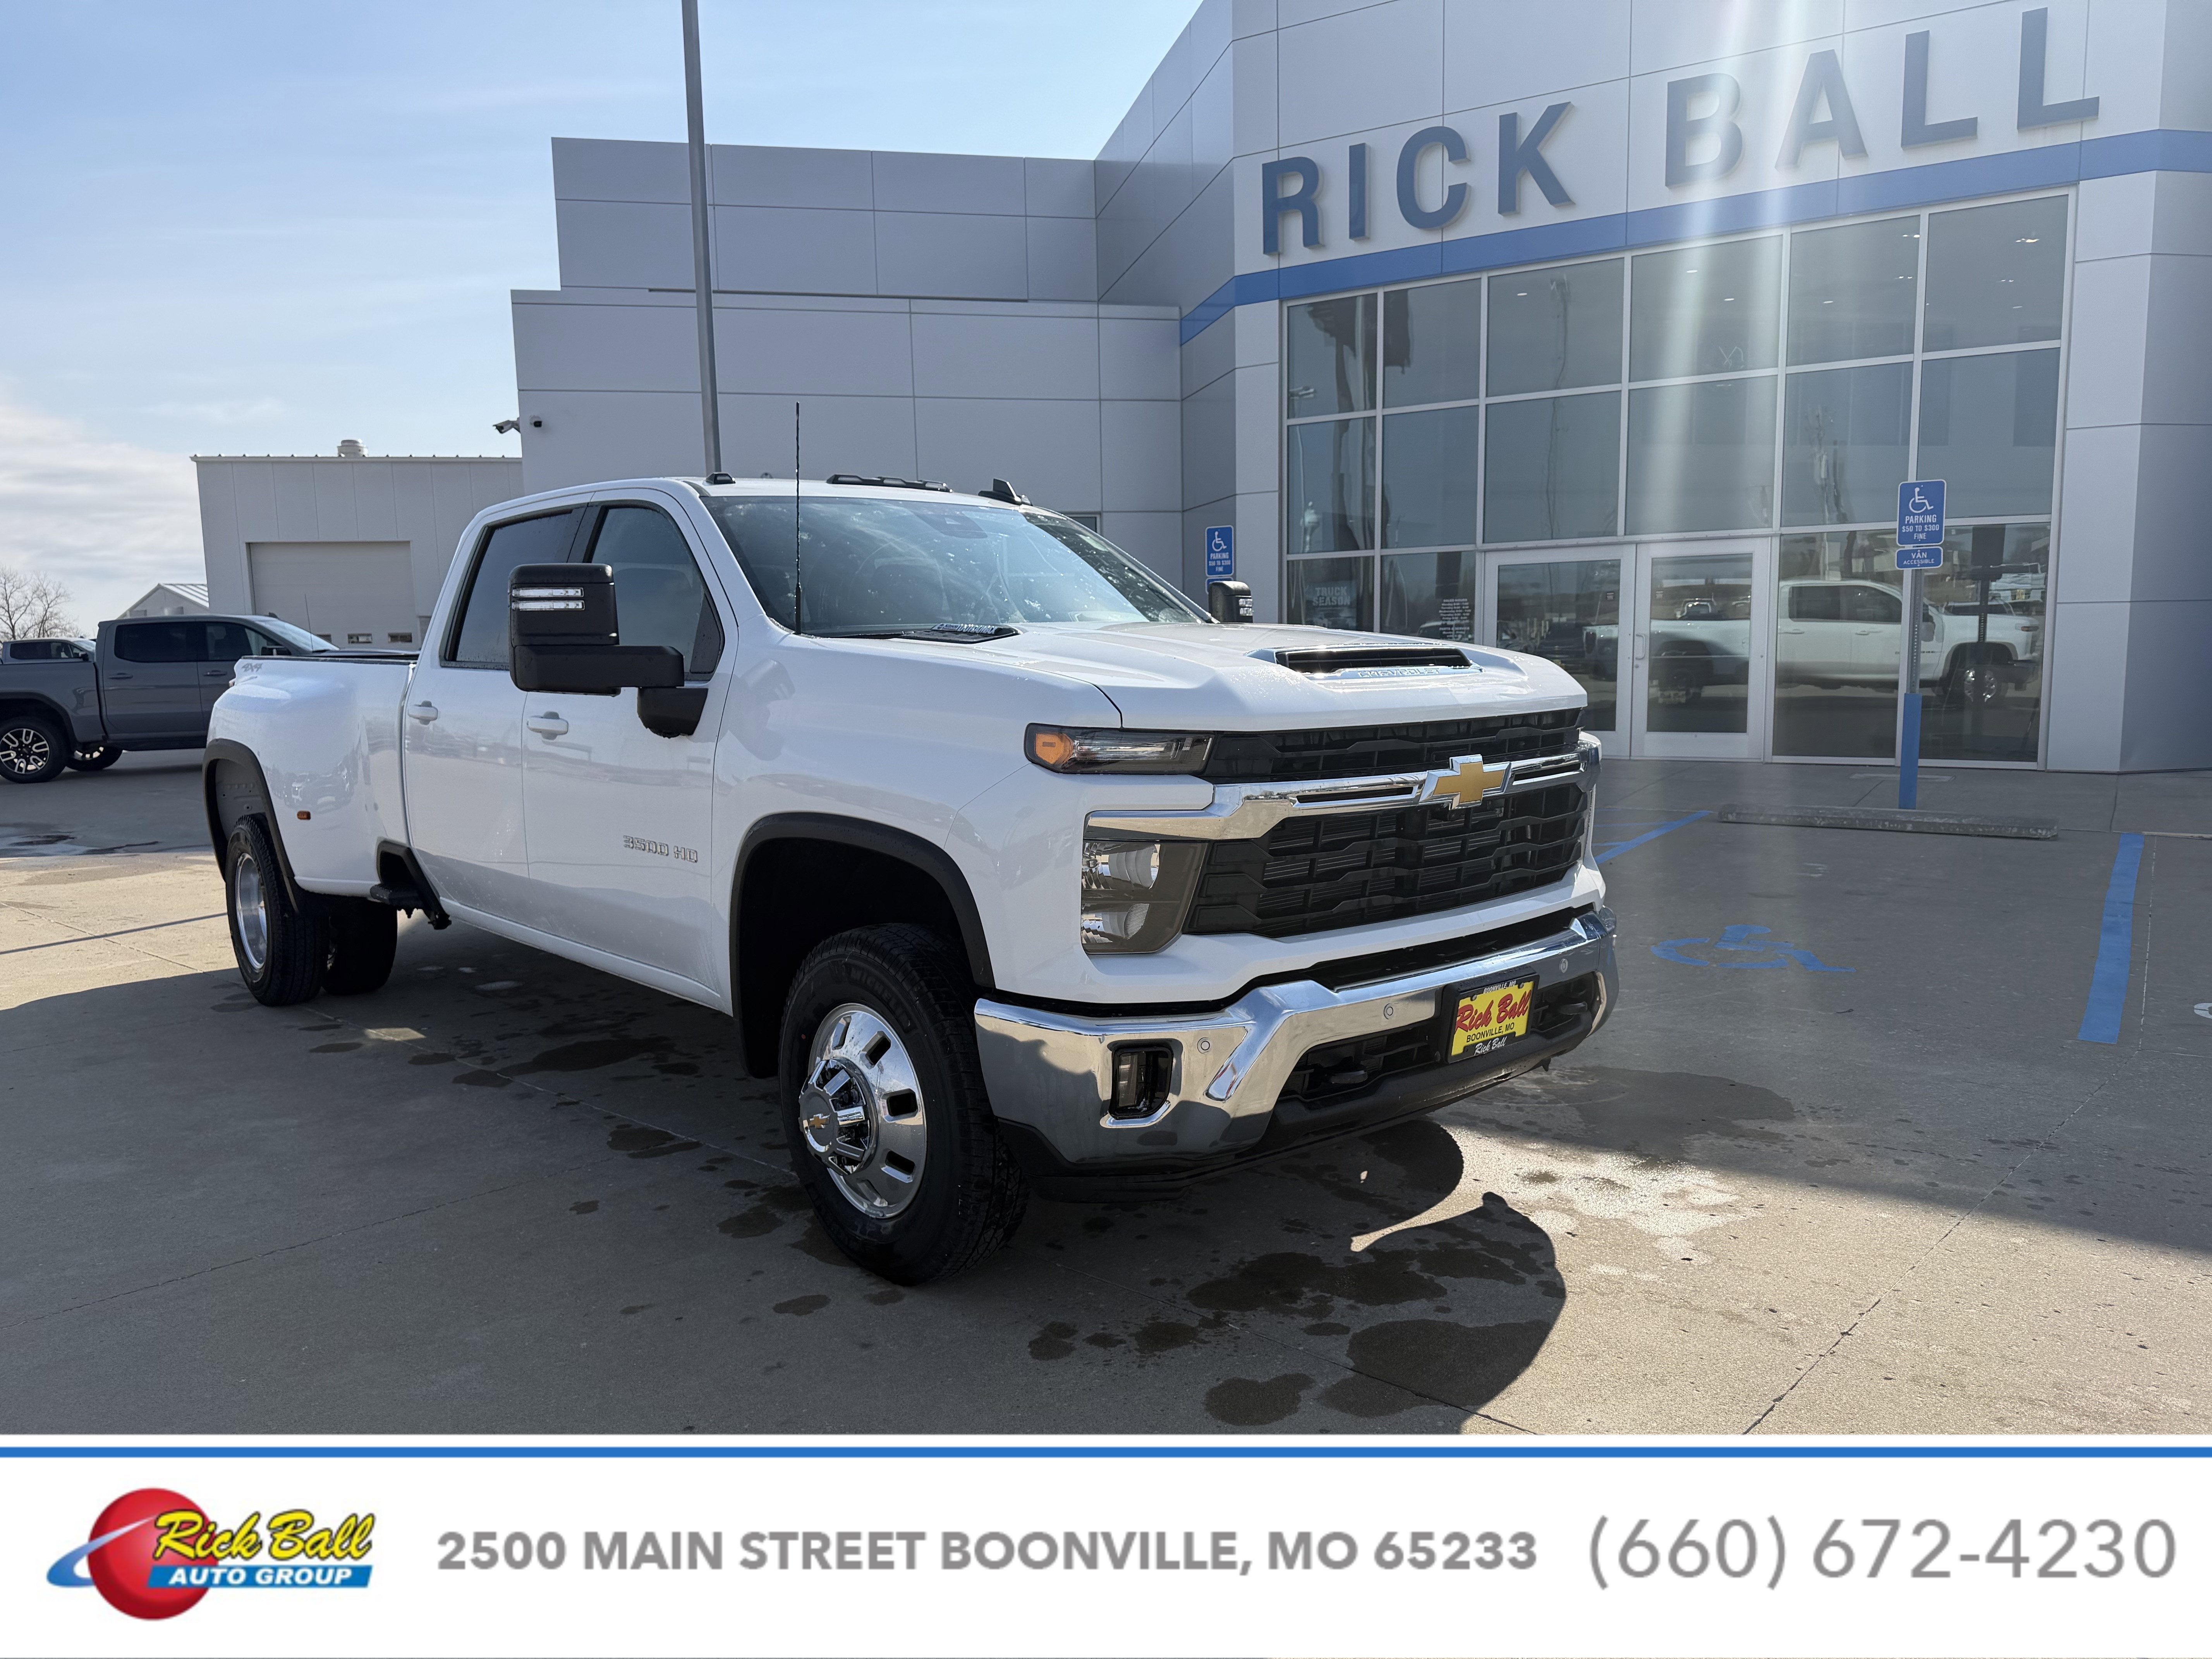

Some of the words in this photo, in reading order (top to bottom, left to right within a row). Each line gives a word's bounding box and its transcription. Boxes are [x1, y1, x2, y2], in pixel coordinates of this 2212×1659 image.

[1262, 101, 1576, 256] RICK
[1665, 7, 2100, 188] BALL
[1905, 514, 1937, 524] PARKING
[1313, 596, 1350, 606] SEASON
[1315, 587, 1347, 596] TRUCK
[1358, 668, 1439, 677] CHEVROLET
[623, 835, 669, 857] 3500
[673, 845, 698, 863] HD
[1455, 1000, 1494, 1032] Rick
[1496, 989, 1532, 1024] Ball
[1466, 1025, 1504, 1043] BOONVILLE,
[1505, 1022, 1515, 1032] MO
[1474, 1040, 1491, 1056] Rick
[1491, 1036, 1507, 1050] Ball
